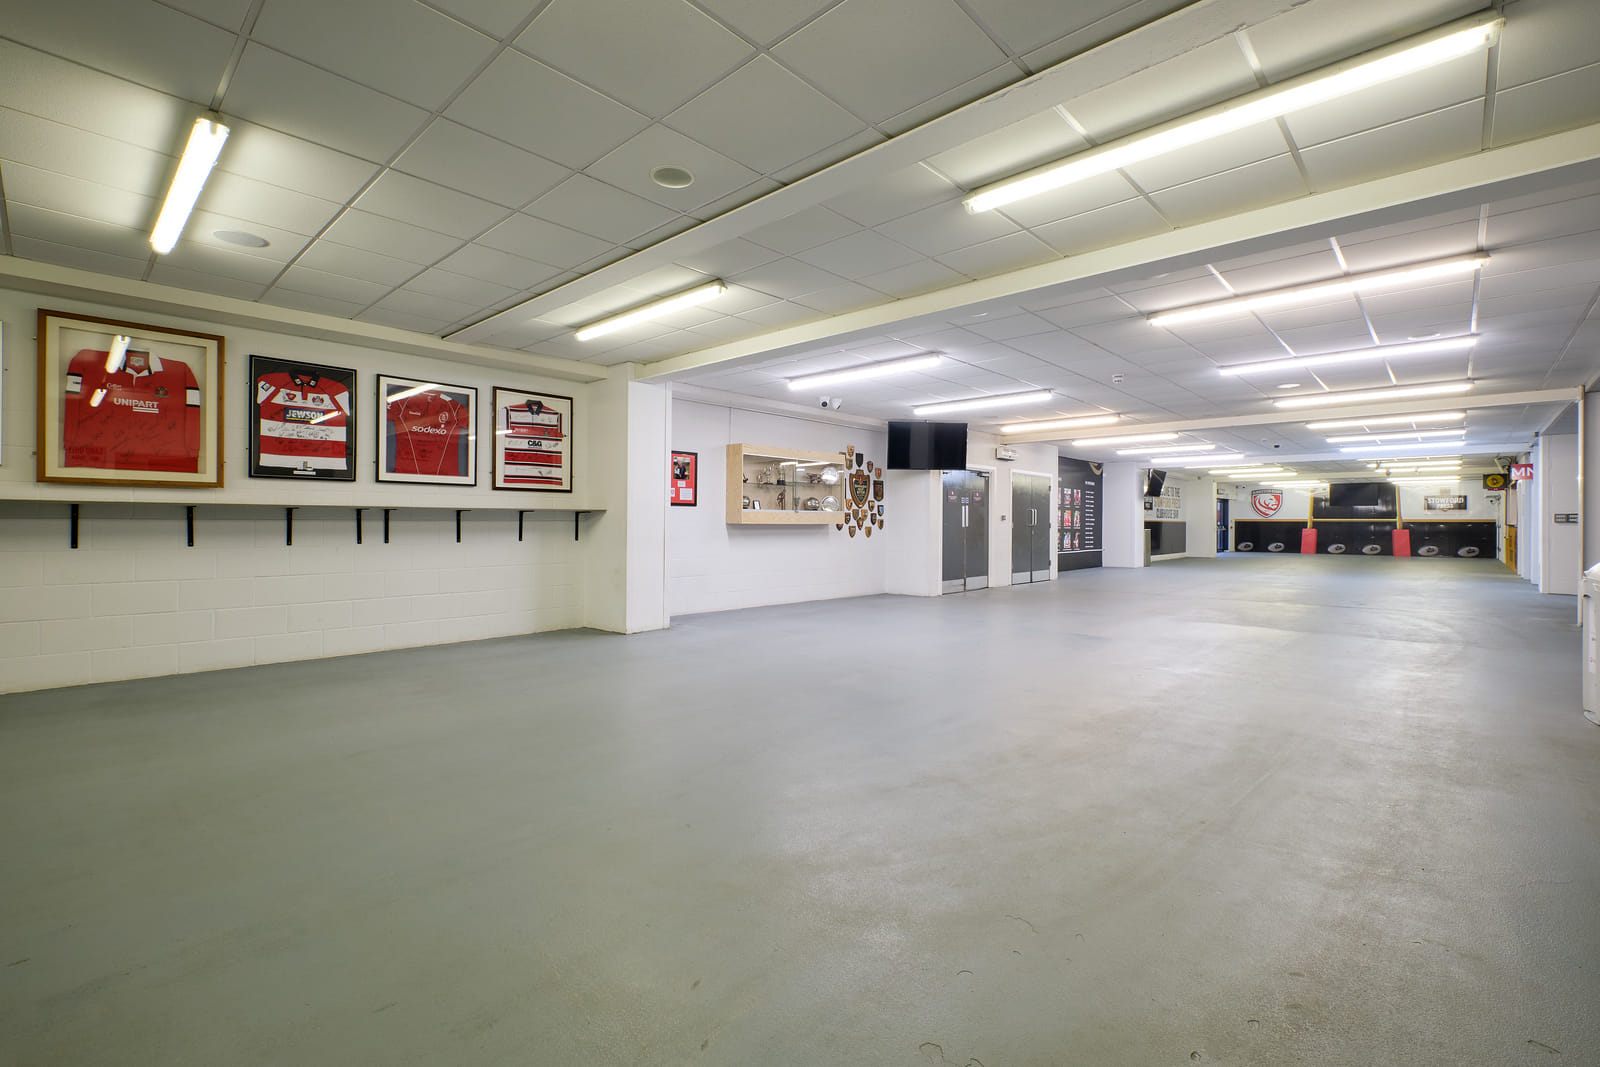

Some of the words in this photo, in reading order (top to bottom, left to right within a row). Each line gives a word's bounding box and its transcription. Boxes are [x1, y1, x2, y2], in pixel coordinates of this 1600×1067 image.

[113, 397, 160, 409] UNIPART
[285, 409, 324, 420] JEWSON
[411, 424, 447, 435] sodexo
[527, 439, 542, 447] C&G
